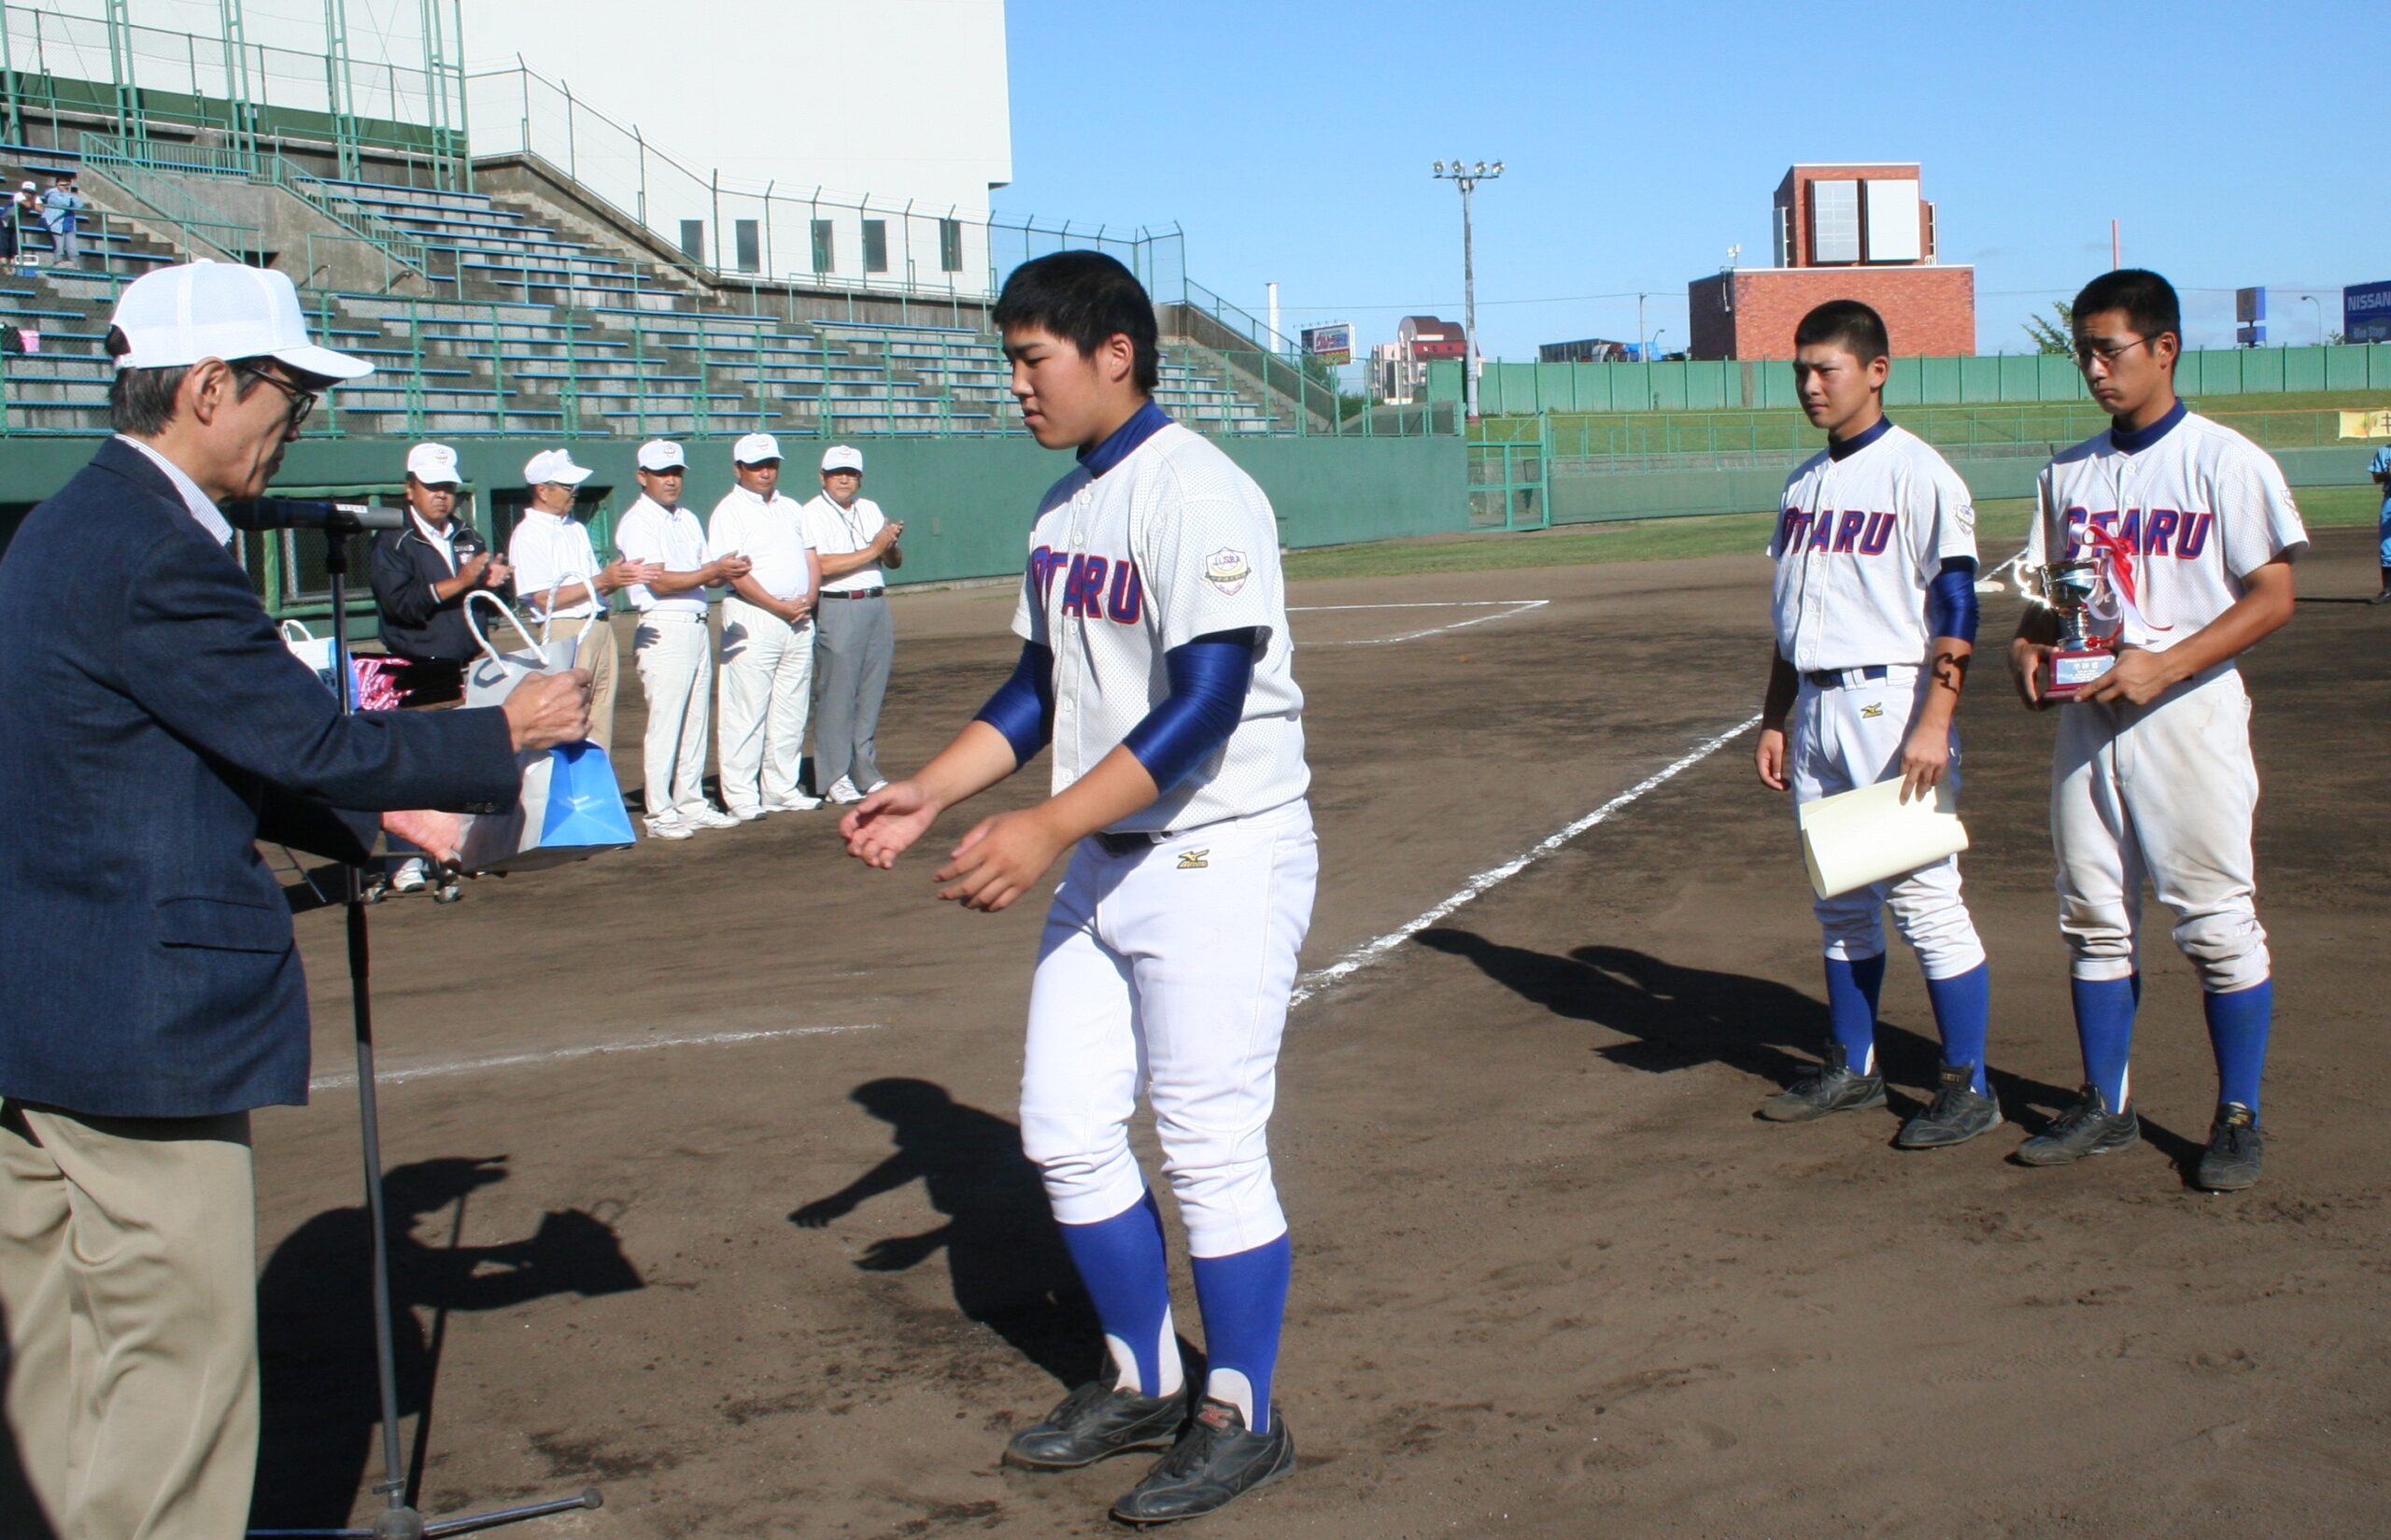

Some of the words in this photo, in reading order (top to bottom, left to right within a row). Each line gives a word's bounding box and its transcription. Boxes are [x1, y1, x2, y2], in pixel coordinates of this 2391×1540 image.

[2347, 291, 2391, 311] NISSAN
[1779, 506, 1897, 556] OTARU
[1031, 544, 1142, 625] OTARU
